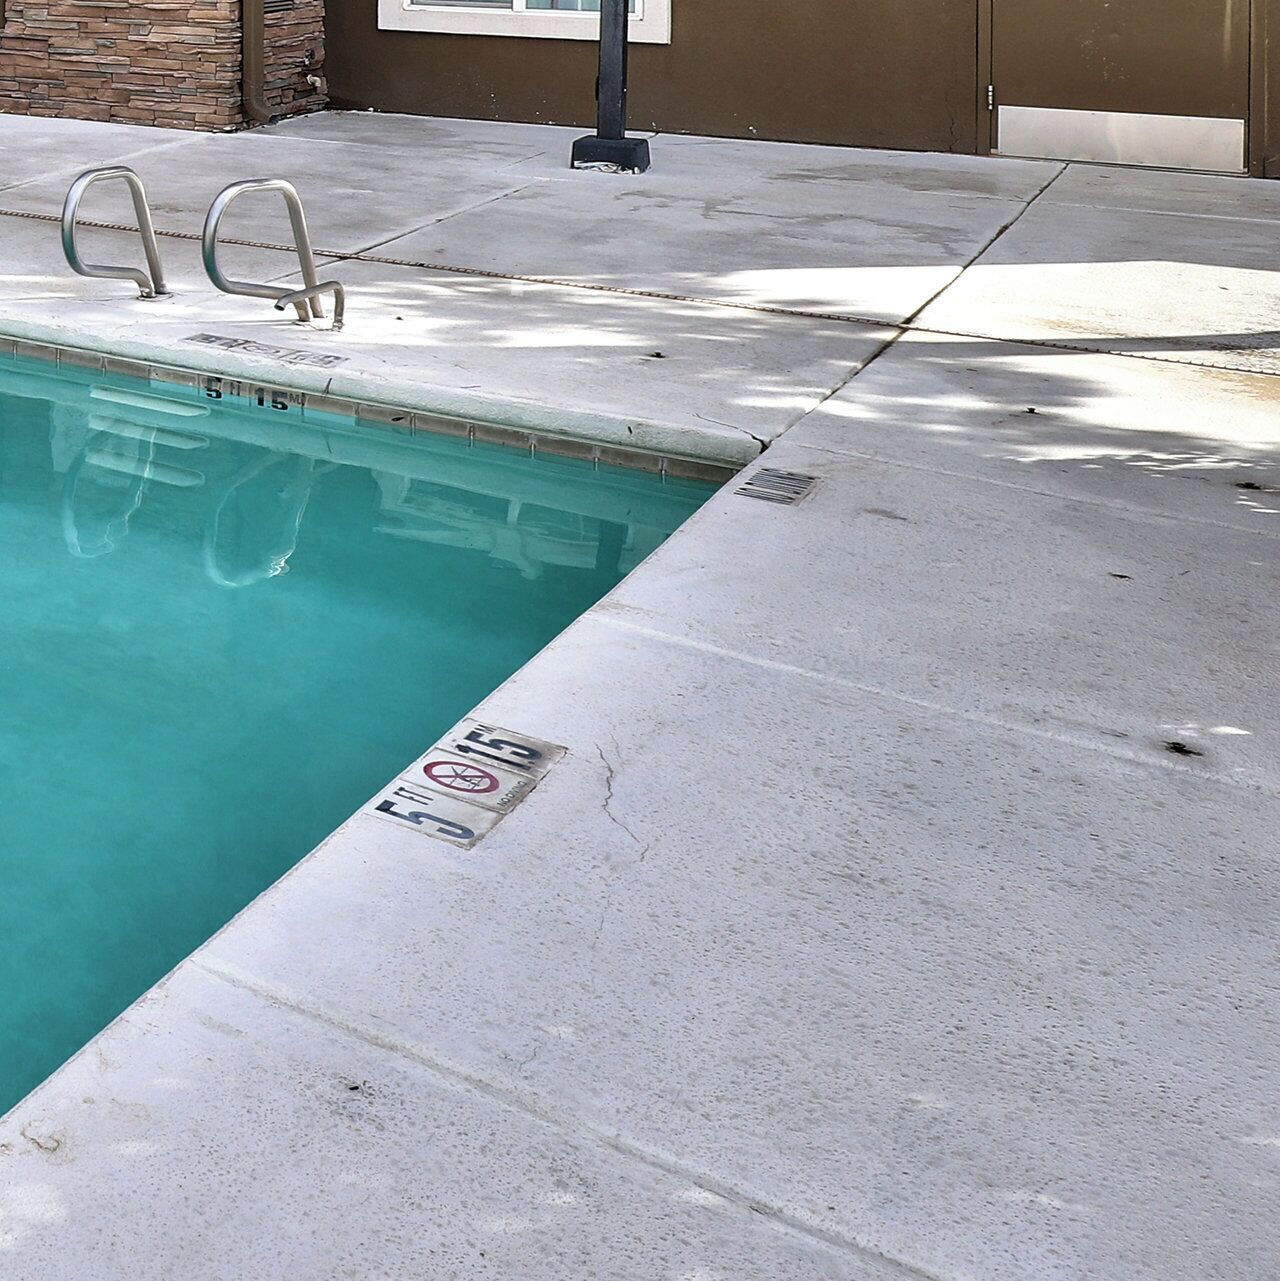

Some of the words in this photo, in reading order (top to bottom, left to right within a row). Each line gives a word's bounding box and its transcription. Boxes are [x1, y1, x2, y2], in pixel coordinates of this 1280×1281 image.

[205, 376, 223, 399] 5
[392, 786, 434, 806] FT
[497, 795, 510, 808] NO
[507, 781, 528, 799] DIVING
[374, 798, 475, 839] 5
